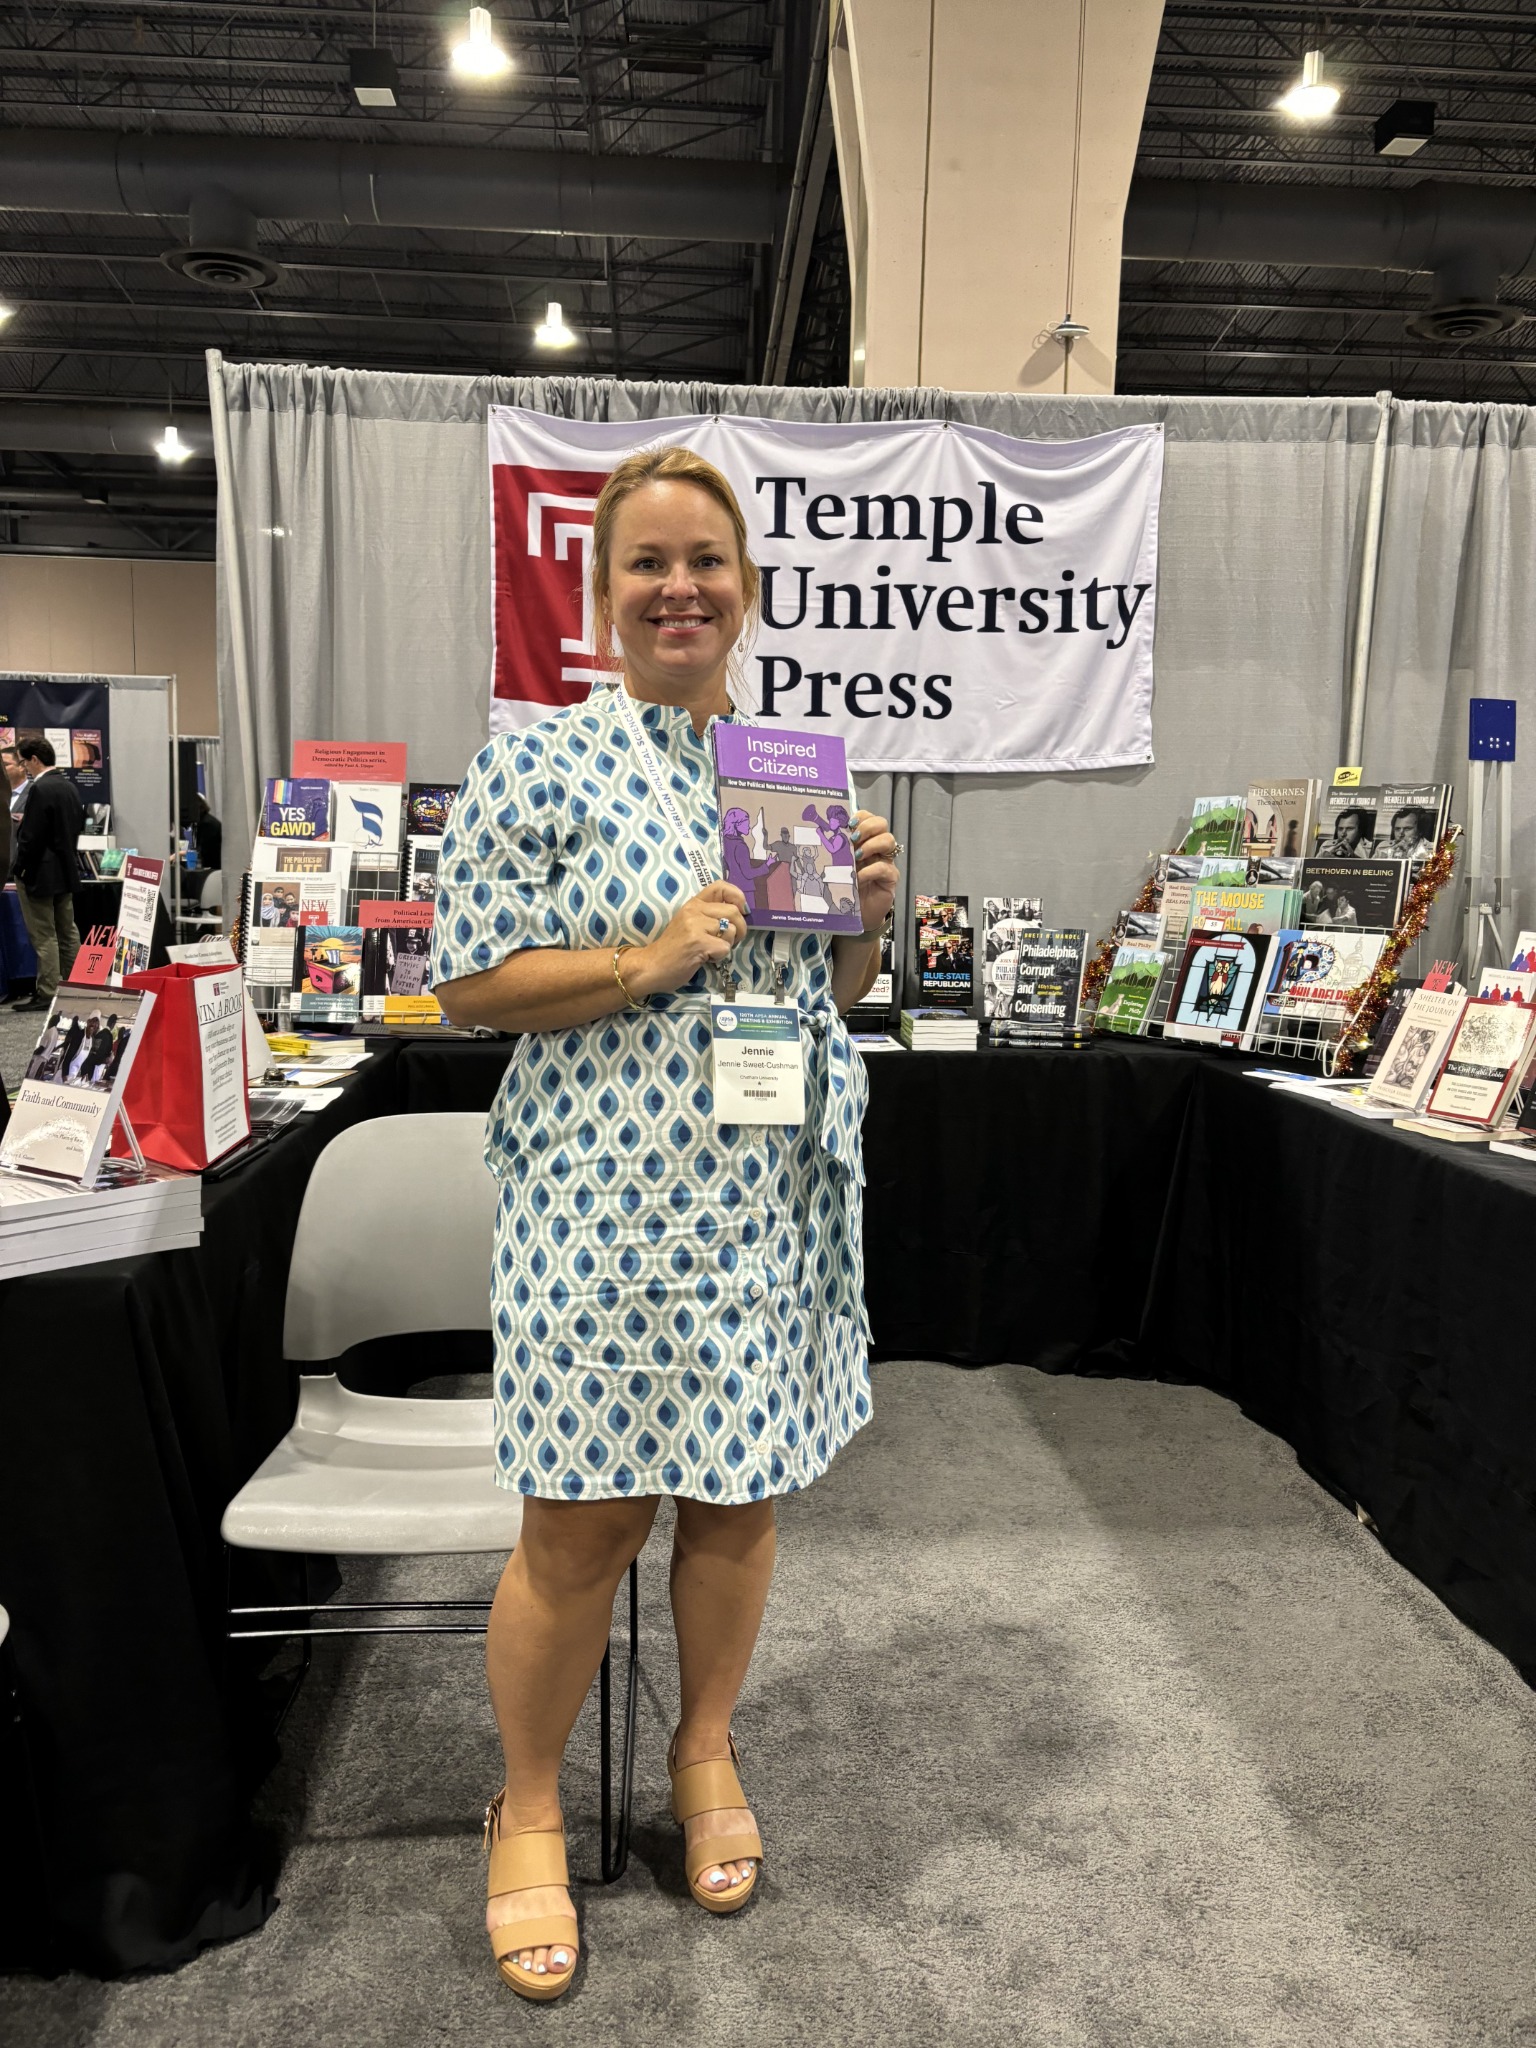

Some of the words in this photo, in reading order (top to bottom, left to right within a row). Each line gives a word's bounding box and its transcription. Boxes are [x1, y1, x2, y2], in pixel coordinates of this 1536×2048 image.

[756, 476, 1044, 562] Temple
[760, 564, 1152, 649] University
[755, 655, 952, 720] Press
[624, 712, 645, 748] SCIENCE
[748, 736, 817, 758] Inspired
[642, 748, 666, 792] POLITICAL
[748, 756, 819, 779] Citizens
[766, 782, 776, 790] Role
[776, 784, 792, 792] Models
[792, 786, 806, 794] Shape
[806, 787, 826, 796] American
[1252, 788, 1268, 796] THE
[1270, 788, 1304, 796] BARNES
[1356, 798, 1370, 806] YOUNG
[1384, 796, 1406, 804] WENDELL
[1412, 796, 1428, 804] YOUNG
[279, 807, 306, 822] YES
[662, 793, 690, 839] AMERICAN
[270, 822, 316, 836] GAWD!
[284, 856, 294, 864] THE
[294, 856, 316, 864] POLITICS
[688, 850, 708, 888] BRIDGE
[302, 899, 328, 912] NEW
[1196, 890, 1218, 907] THE
[1220, 892, 1265, 910] MOUSE
[1200, 907, 1214, 916] Who
[1214, 908, 1236, 918] Played
[1192, 915, 1244, 931] FOALL
[83, 925, 124, 948] NEW
[1022, 944, 1079, 960] Philadelphia,
[923, 972, 970, 980] BLUE-STATE
[996, 966, 1018, 974] PHILAD
[1020, 962, 1054, 978] Corrupt
[1430, 960, 1458, 976] NEW
[922, 980, 970, 988] REPUBLICAN
[1016, 982, 1034, 994] and
[224, 993, 242, 1016] BOOK
[1123, 999, 1144, 1008] Exploring
[1420, 994, 1446, 1004] SHELTER
[1014, 1000, 1066, 1018] Consenting
[1413, 1002, 1426, 1012] THE
[1426, 1004, 1456, 1016] JOURNEY
[742, 1046, 774, 1056] Jennie
[718, 1060, 742, 1068] Jennie
[742, 1060, 798, 1070] Sweet-Cushman
[1458, 1064, 1471, 1074] Civil
[1471, 1067, 1488, 1076] Rights
[1488, 1069, 1504, 1080] Lobby
[20, 1089, 40, 1104] Faith
[40, 1096, 56, 1107] and
[55, 1095, 102, 1118] Community
